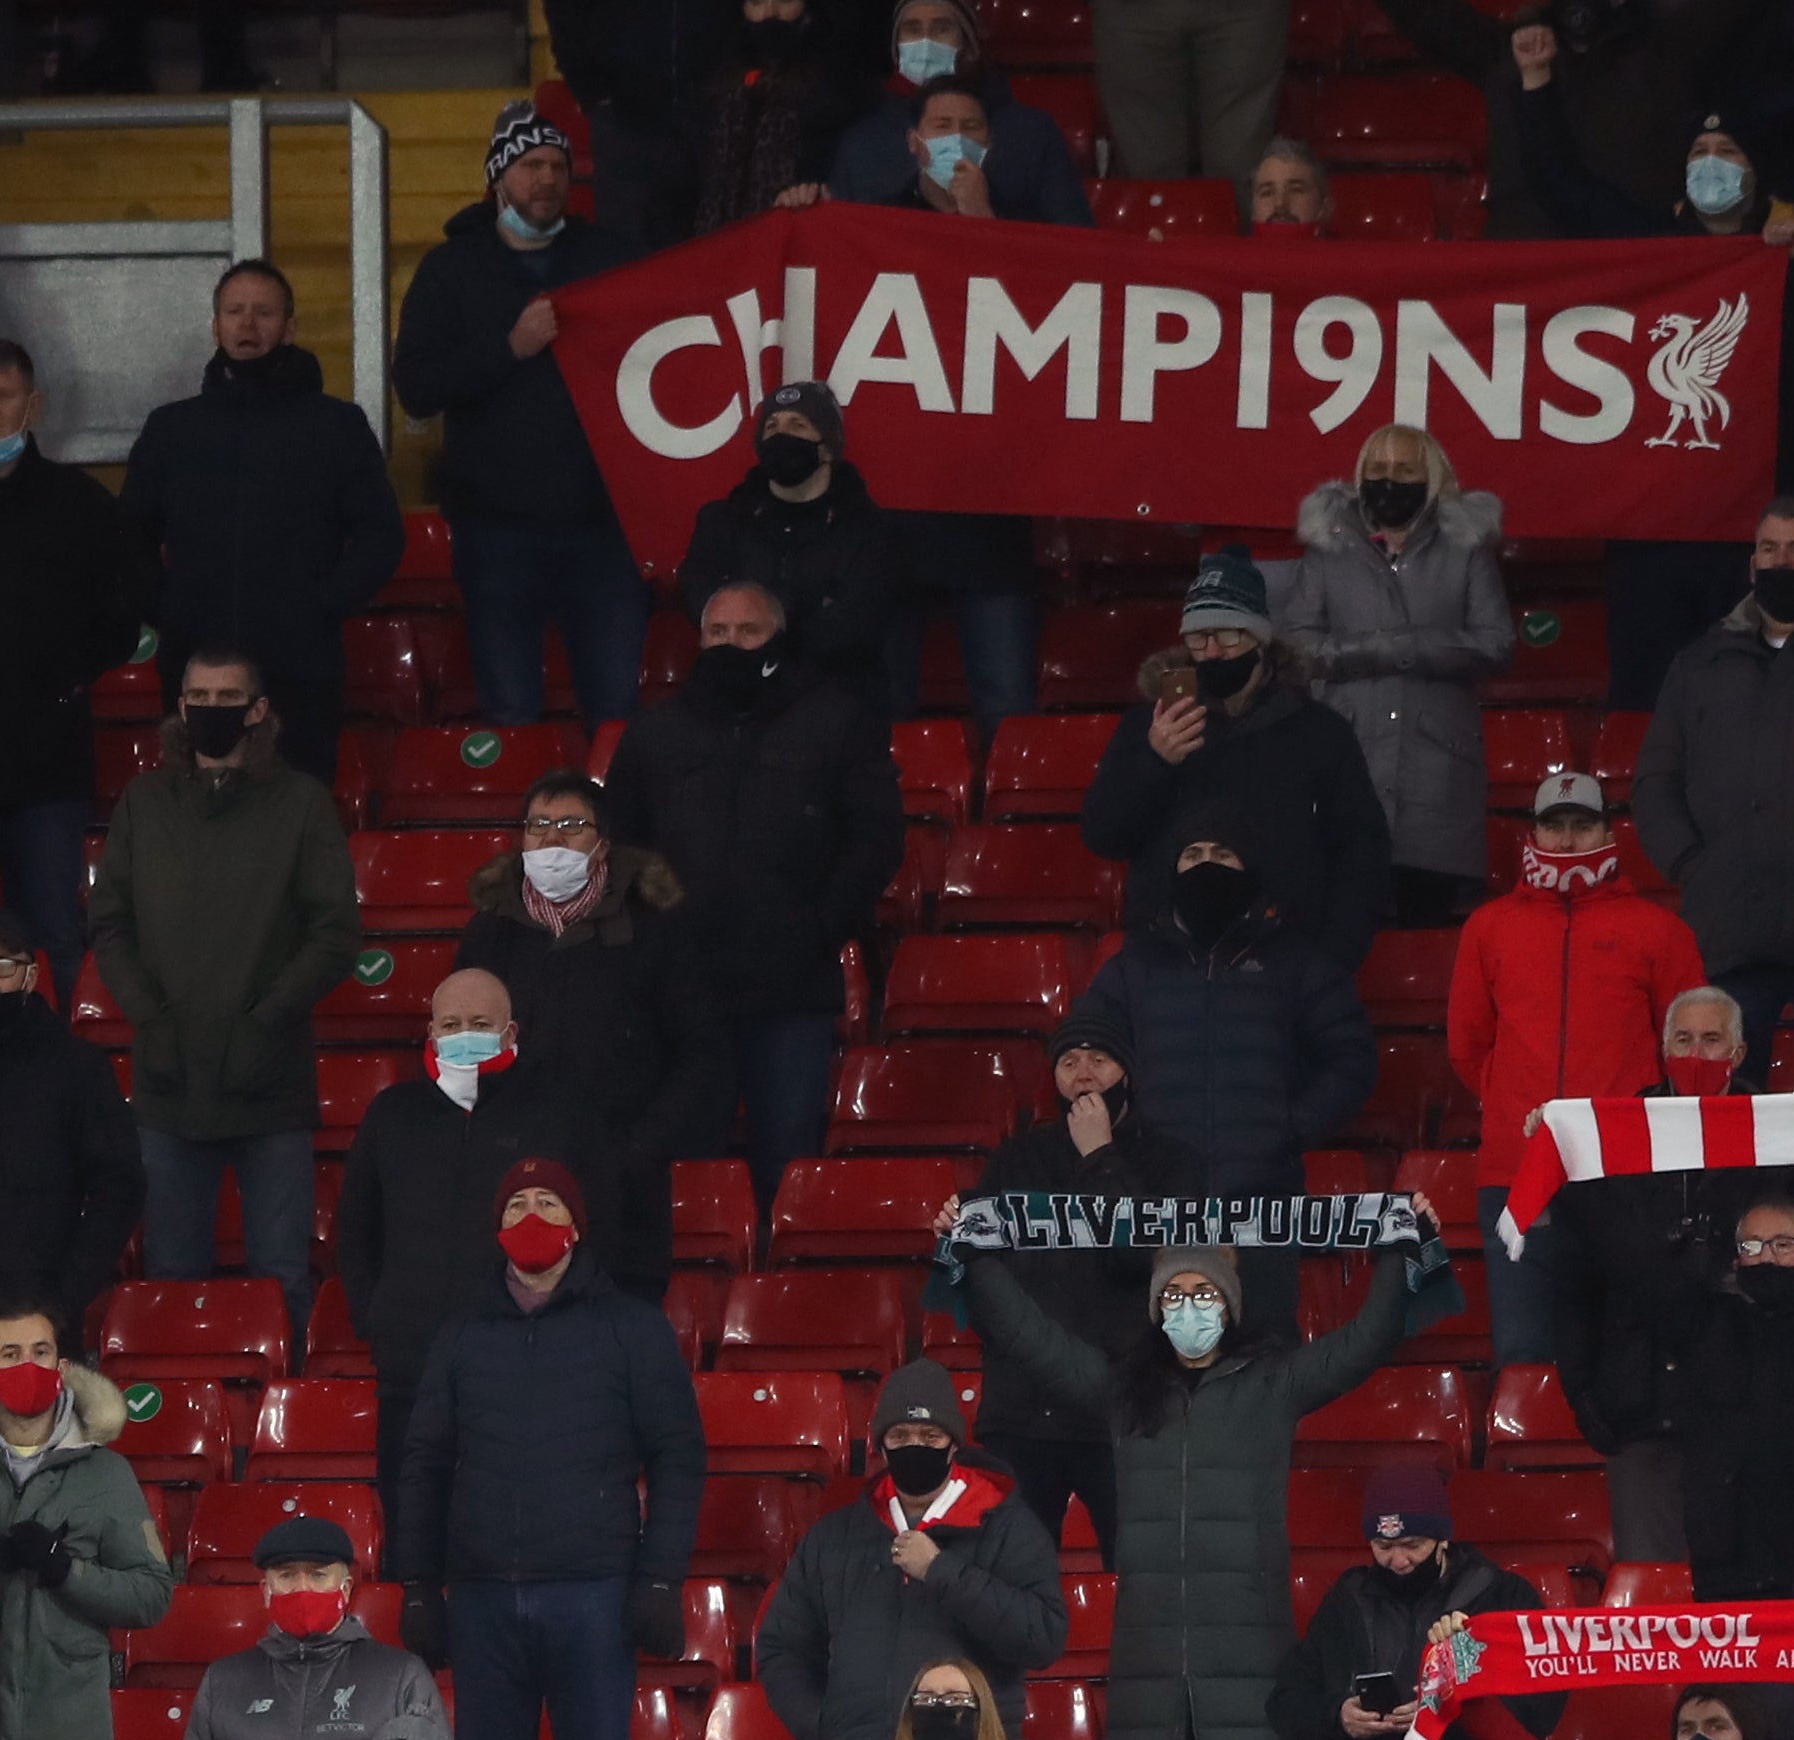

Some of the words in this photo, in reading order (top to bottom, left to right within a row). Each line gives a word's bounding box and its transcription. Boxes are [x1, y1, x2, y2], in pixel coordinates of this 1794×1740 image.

[1006, 1194, 1380, 1249] LIVERPOOL
[1516, 1612, 1761, 1657] LIVERPOOL
[1525, 1655, 1598, 1679] YOU'LL
[1613, 1650, 1682, 1675] NEVER
[1698, 1648, 1758, 1669] WALK
[329, 1709, 350, 1720] LFC
